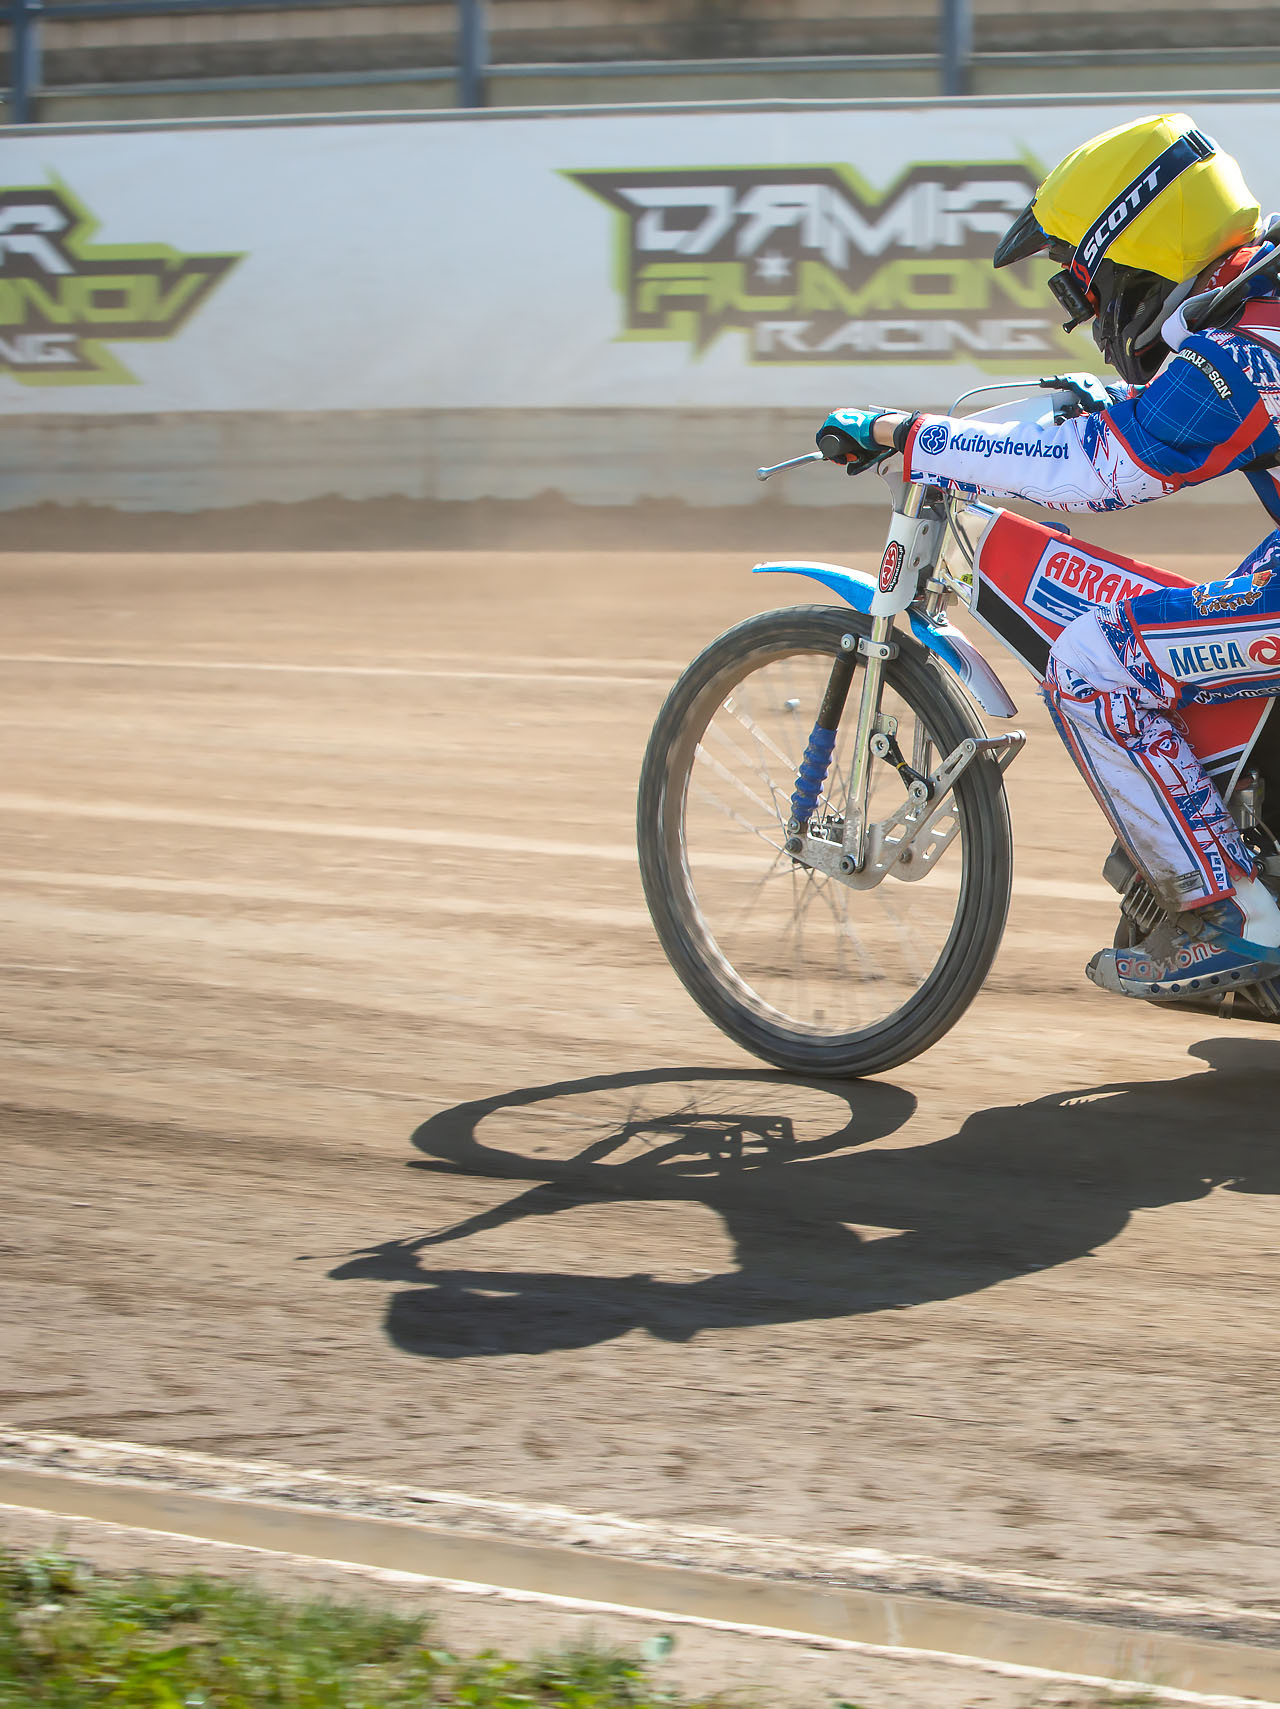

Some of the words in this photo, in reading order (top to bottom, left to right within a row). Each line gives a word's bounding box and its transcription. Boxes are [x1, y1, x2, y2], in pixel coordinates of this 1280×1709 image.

[1083, 165, 1161, 268] SCOTT
[756, 319, 1053, 352] RACING
[949, 433, 1069, 460] KuibyshevAzot
[1045, 551, 1157, 604] ABRAM
[1168, 641, 1247, 677] MEGA
